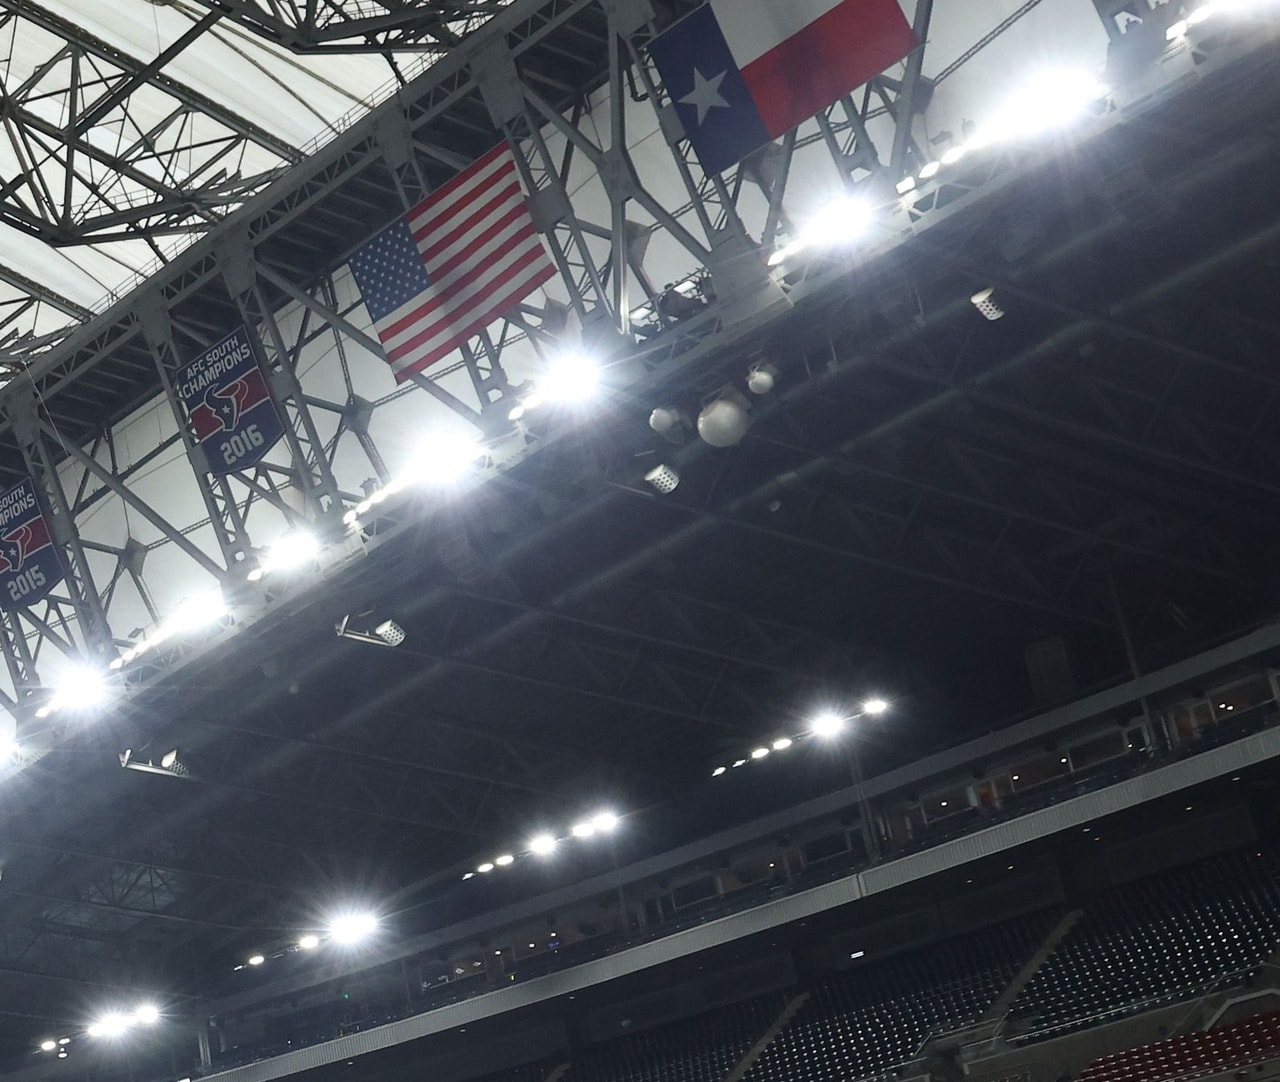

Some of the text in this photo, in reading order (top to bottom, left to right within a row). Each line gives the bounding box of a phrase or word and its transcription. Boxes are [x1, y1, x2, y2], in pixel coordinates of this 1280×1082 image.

[182, 343, 250, 398] CHAMPIONS
[187, 336, 238, 379] AFC SOUTH
[221, 424, 264, 465] 2016
[7, 565, 46, 601] 2015
